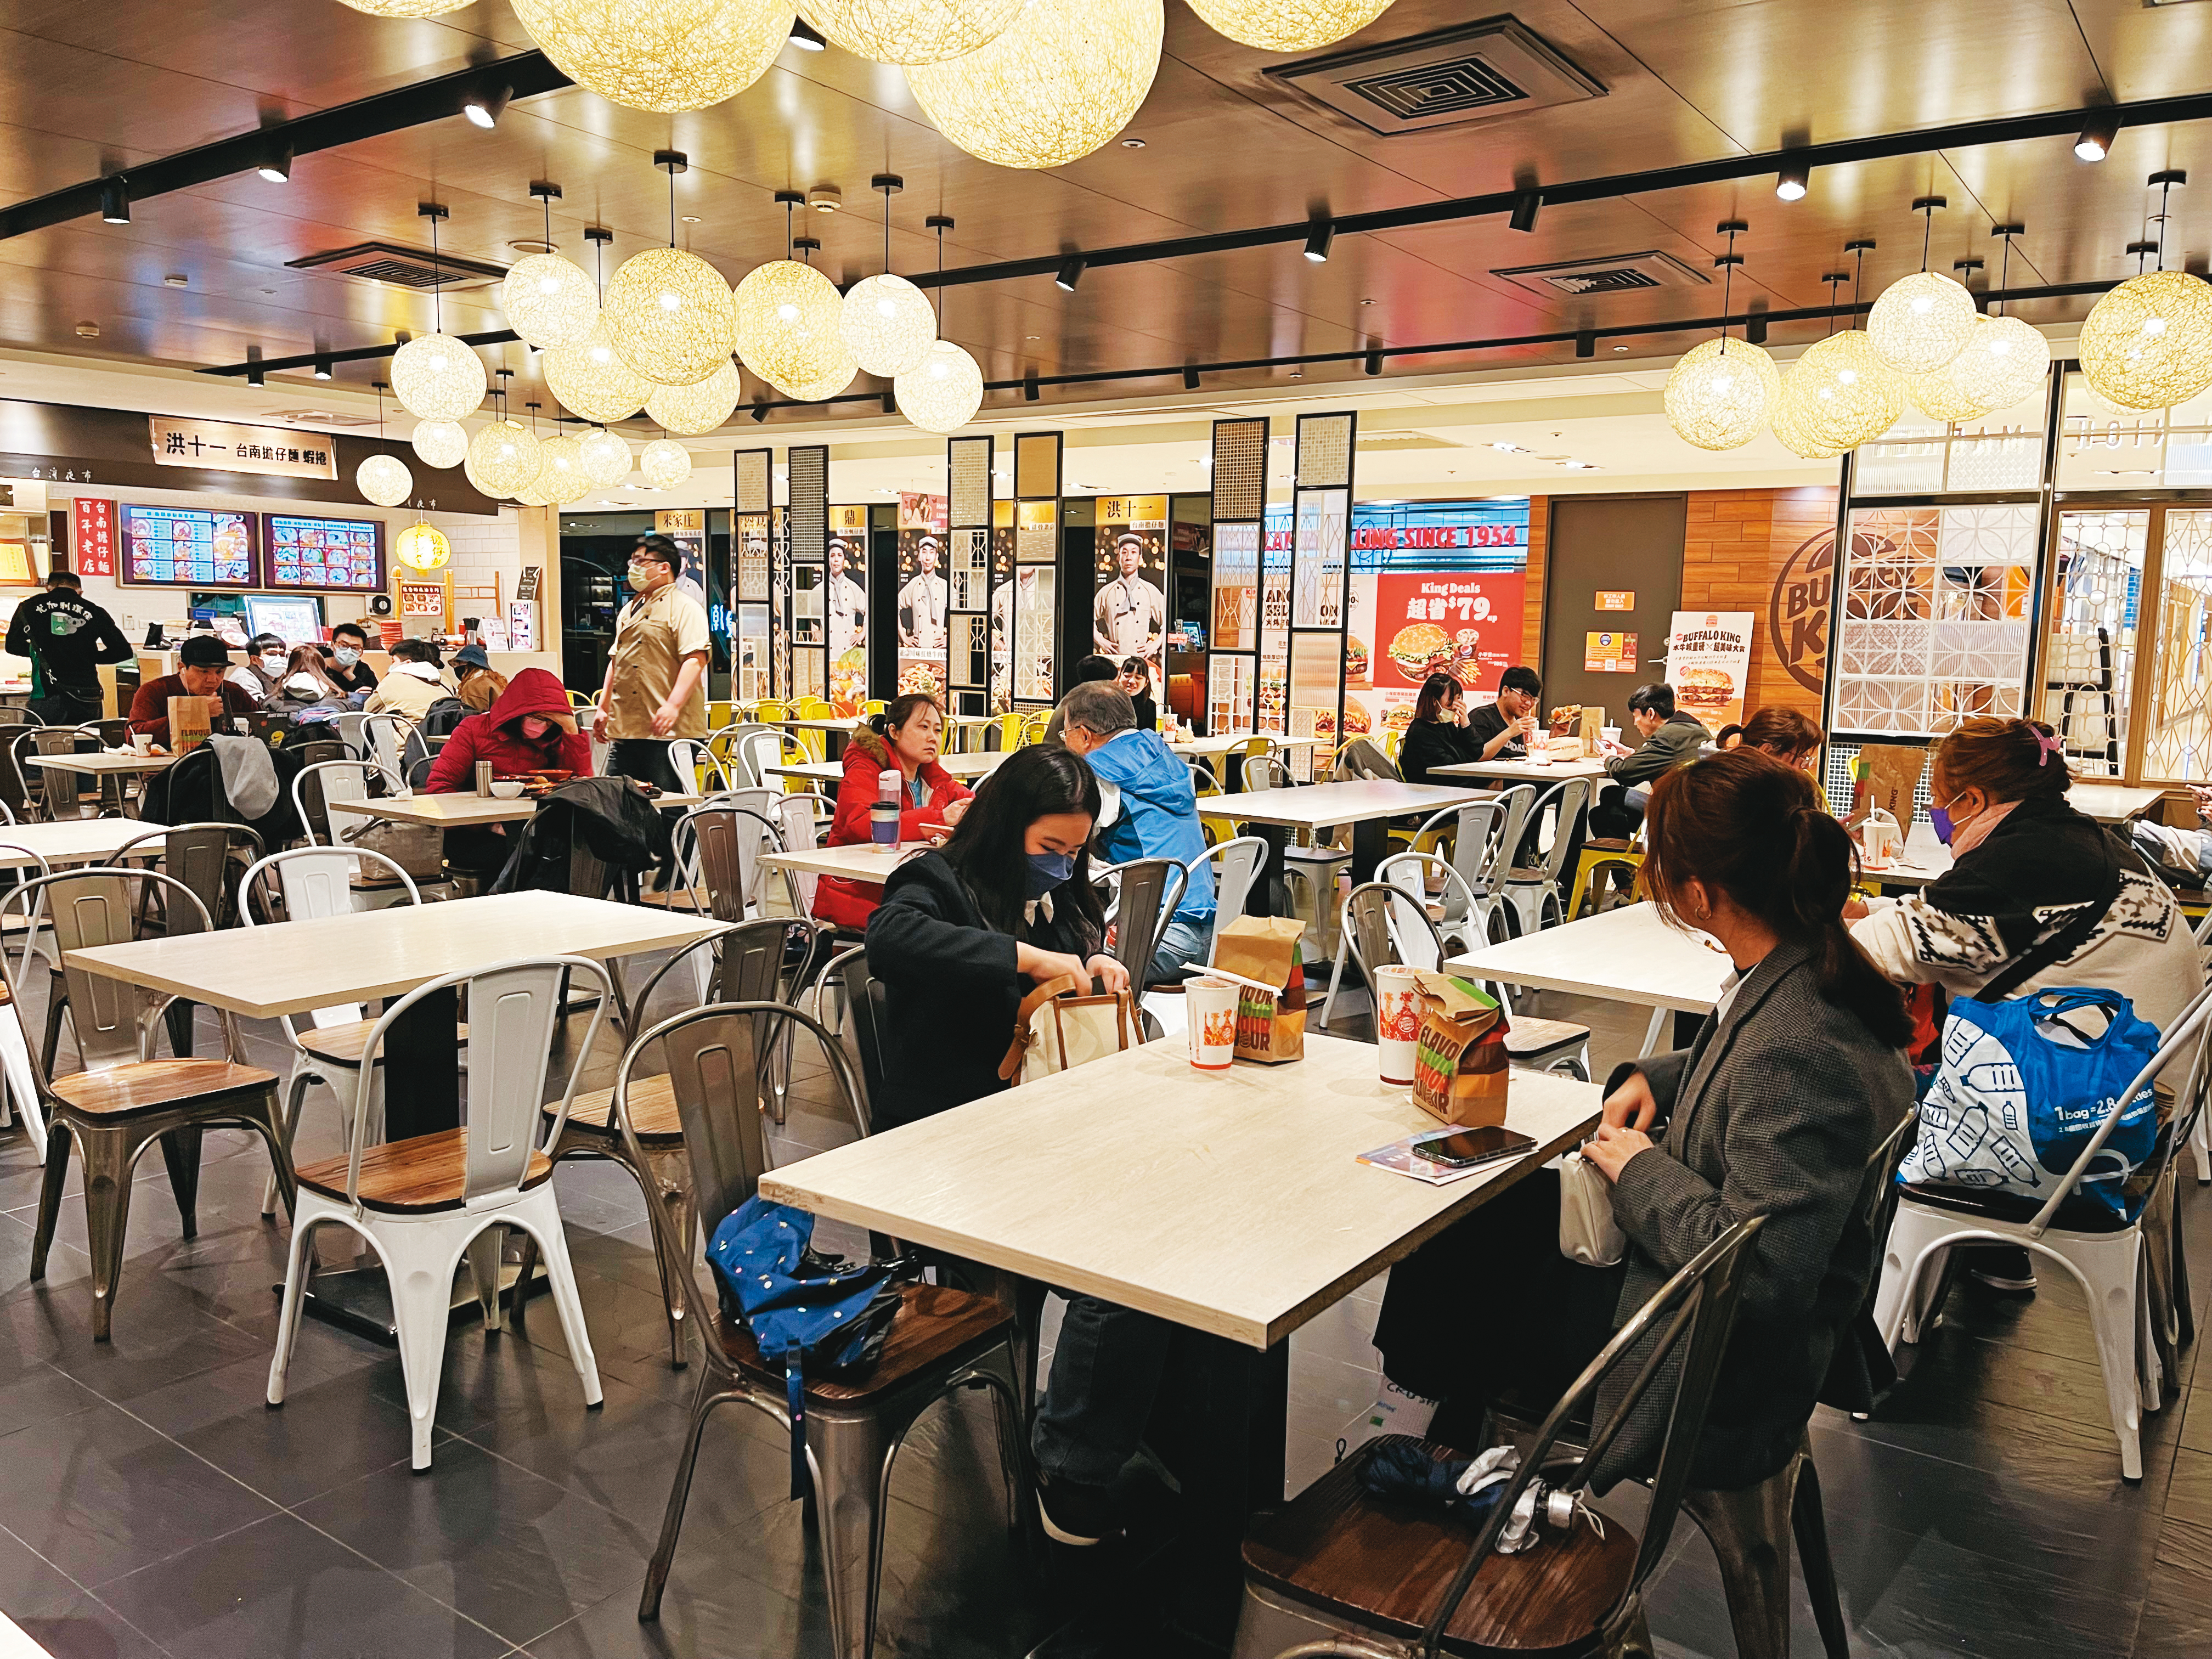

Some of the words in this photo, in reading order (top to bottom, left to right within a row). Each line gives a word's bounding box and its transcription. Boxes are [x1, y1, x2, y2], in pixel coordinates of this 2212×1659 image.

[166, 432, 227, 456] 洪十一
[1107, 500, 1153, 518] 洪十一
[663, 513, 695, 528] 米家庄
[80, 500, 95, 573] 百年老店
[1350, 528, 1399, 549] LING
[1404, 526, 1458, 548] SINCE
[1465, 525, 1517, 548] 1954
[1421, 582, 1449, 596] King
[1450, 582, 1481, 594] Deals
[1407, 598, 1447, 620] 超省
[1683, 630, 1719, 642] BUFFALO
[1720, 631, 1741, 644] KING
[1421, 1025, 1463, 1061] FLAVO
